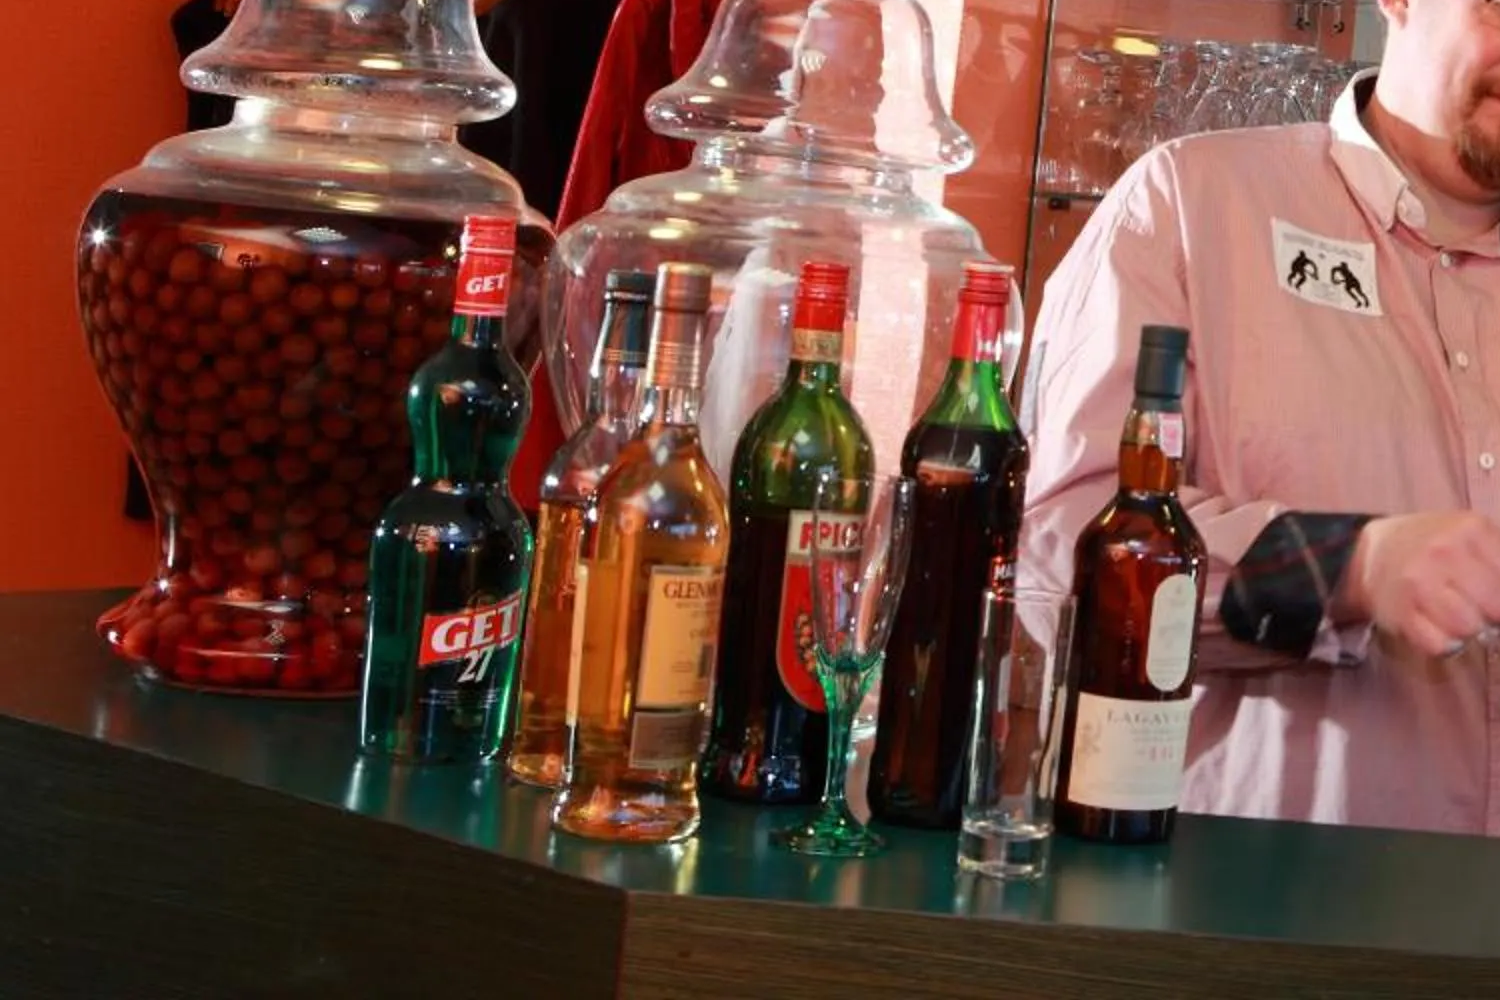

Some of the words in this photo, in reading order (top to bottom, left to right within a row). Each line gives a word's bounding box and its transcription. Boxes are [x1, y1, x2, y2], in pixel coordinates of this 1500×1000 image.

[466, 273, 508, 294] GET
[431, 600, 520, 654] GET
[457, 645, 496, 683] 27
